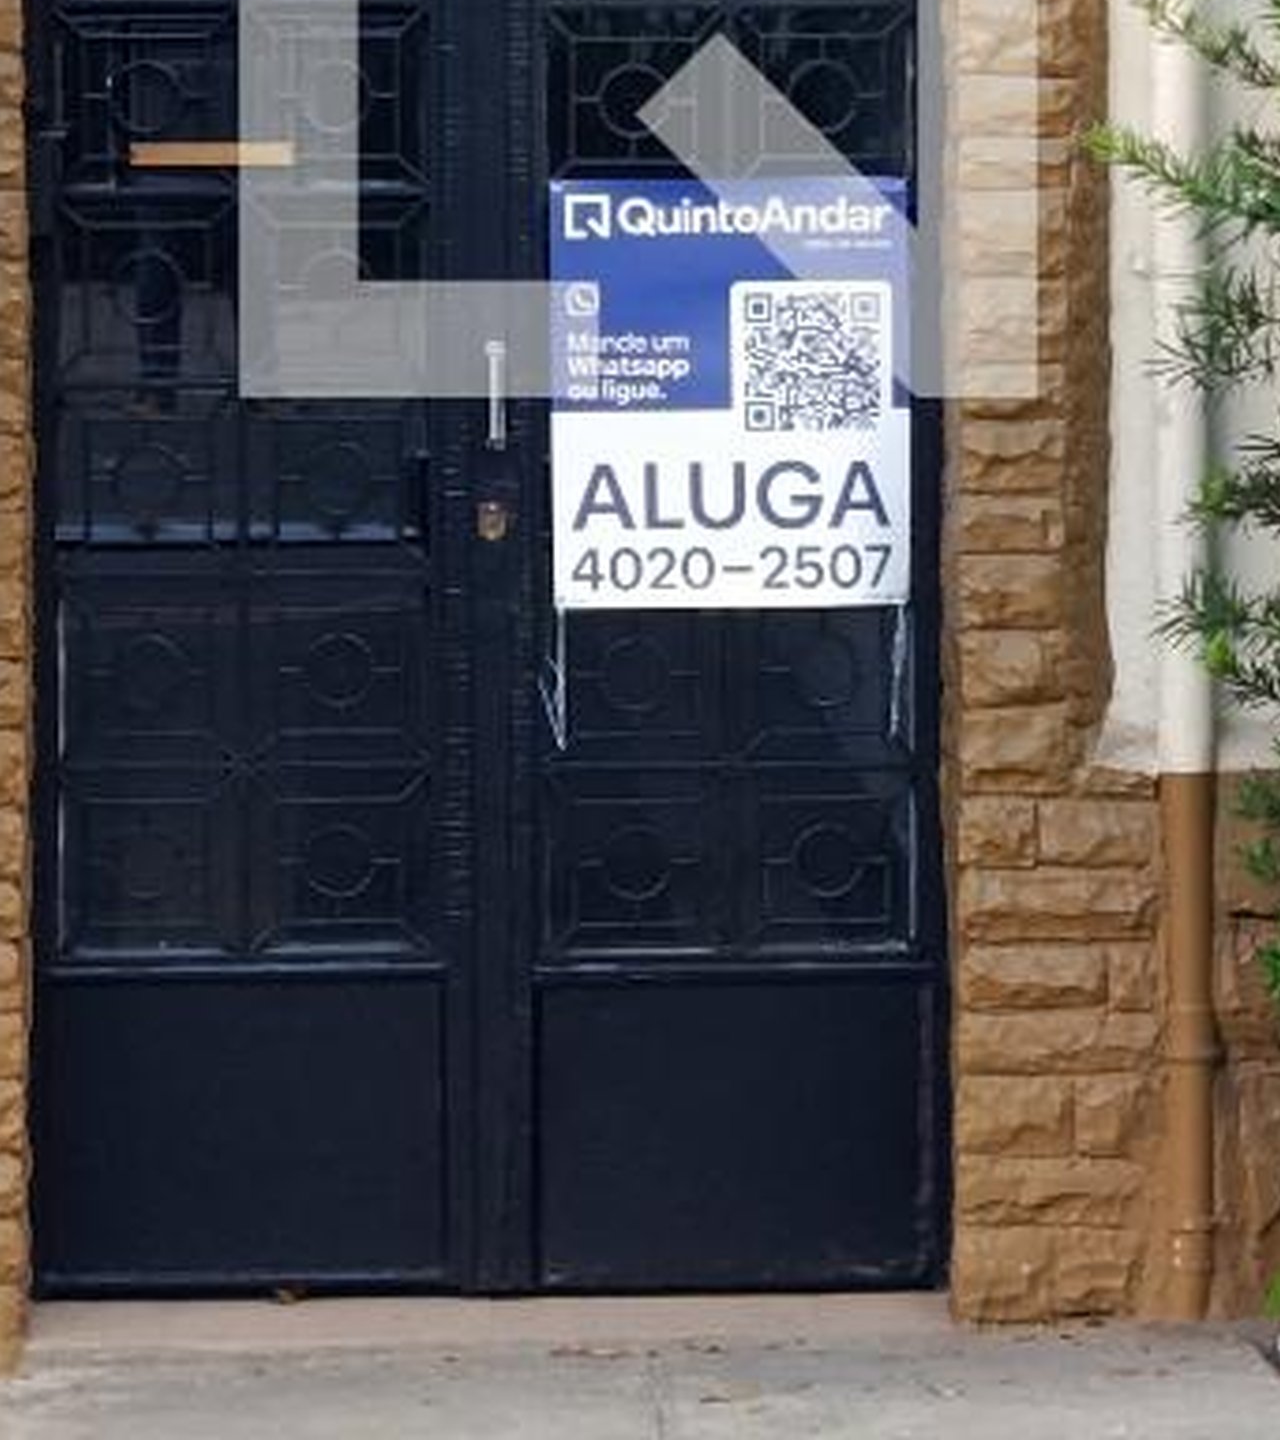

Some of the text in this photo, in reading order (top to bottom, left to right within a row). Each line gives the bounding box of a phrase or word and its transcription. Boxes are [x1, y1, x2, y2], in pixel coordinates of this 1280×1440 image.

[617, 197, 893, 237] QuintoAndar
[651, 335, 690, 352] um
[601, 379, 668, 406] ligue.
[572, 460, 891, 532] ALUGA
[571, 544, 892, 591] 4020-2507
